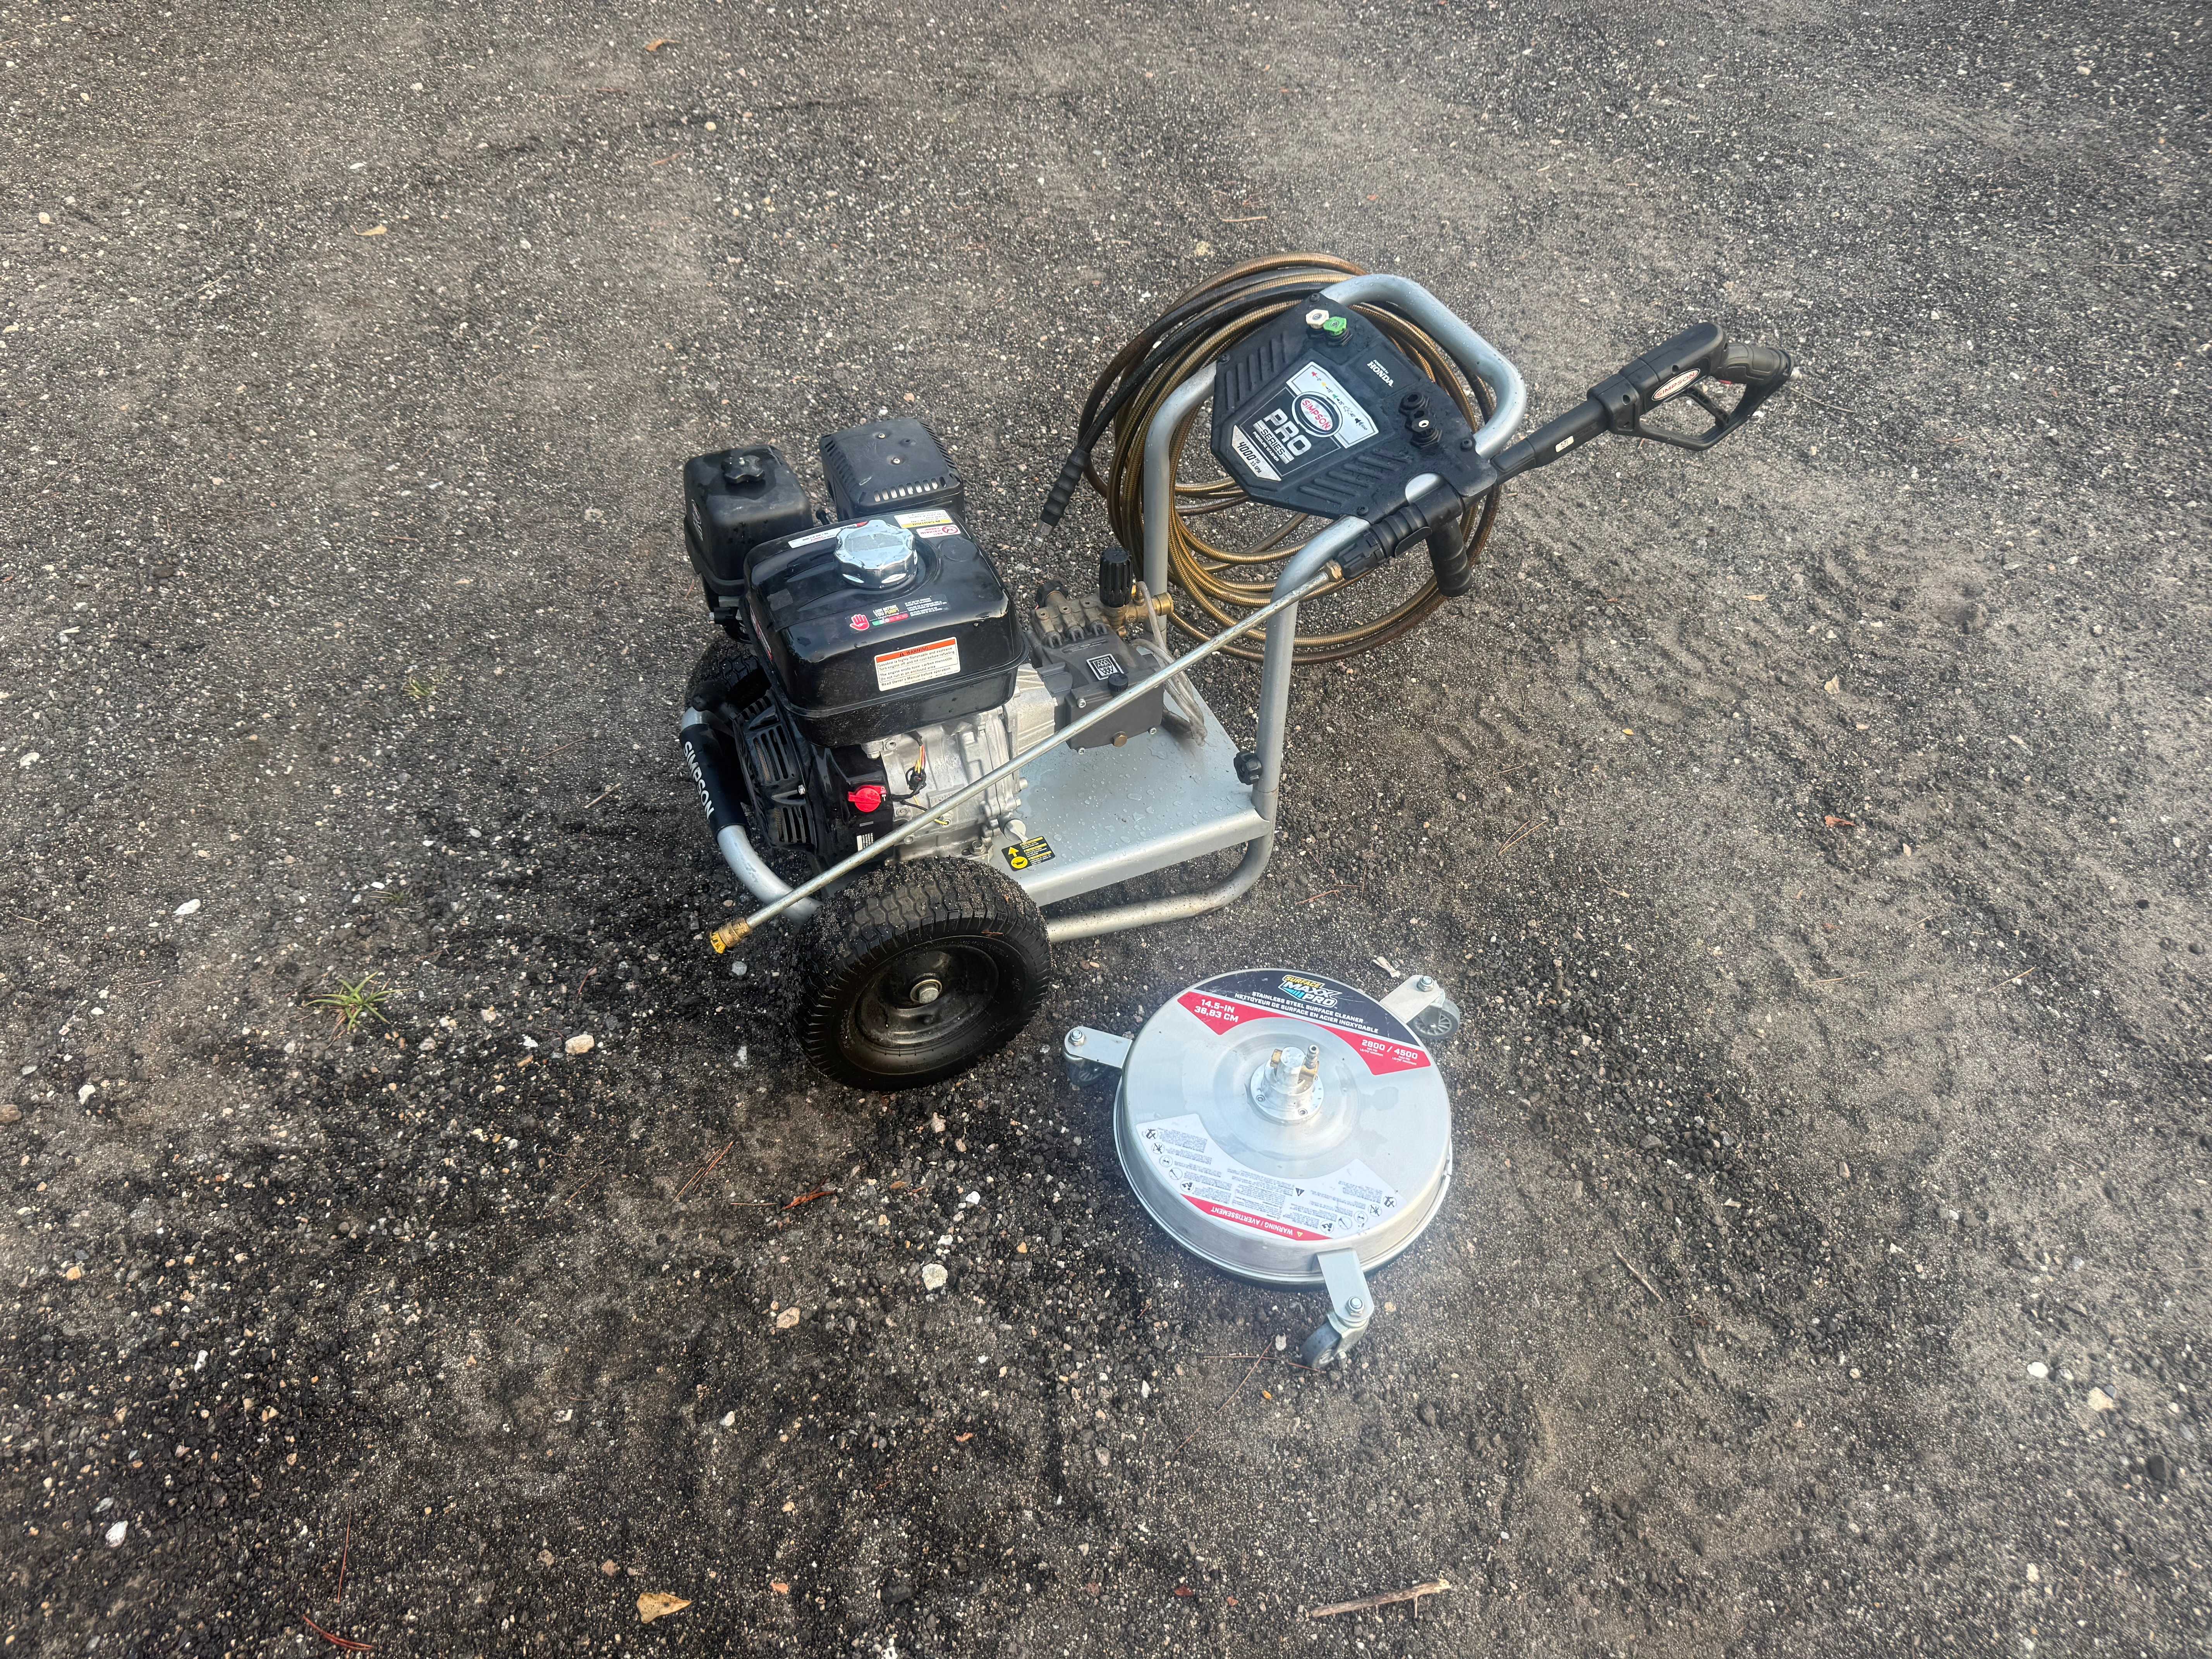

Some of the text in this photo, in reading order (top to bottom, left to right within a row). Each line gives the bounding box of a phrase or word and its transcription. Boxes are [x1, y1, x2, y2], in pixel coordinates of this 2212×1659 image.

[1367, 361, 1394, 387] HONDA
[1656, 372, 1695, 397] SIMPSON
[1302, 399, 1331, 429] SIMPSON
[1261, 429, 1285, 455] SERIES
[1263, 407, 1312, 457] PRO
[1237, 441, 1257, 460] 4000
[683, 741, 714, 820] SIMPSON
[1283, 981, 1335, 998] MAXX
[1285, 976, 1321, 988] SURFACE
[1201, 999, 1235, 1013] 14.5-IN
[1252, 991, 1364, 1024] STAINLESS STEEL SURFACE CLEANER
[1302, 993, 1336, 1006] PRO
[1223, 1013, 1239, 1023] CM
[1235, 993, 1271, 1006] NETTOYEUR
[1280, 1005, 1309, 1015] SURFACE
[1319, 1014, 1338, 1024] ACIER
[1339, 1019, 1379, 1033] INOXYDABLE
[1361, 1039, 1385, 1051] 2800
[1394, 1048, 1418, 1060] 4500
[1210, 1206, 1260, 1226] AVERTISSEMENT
[1264, 1221, 1293, 1236] WARNING
